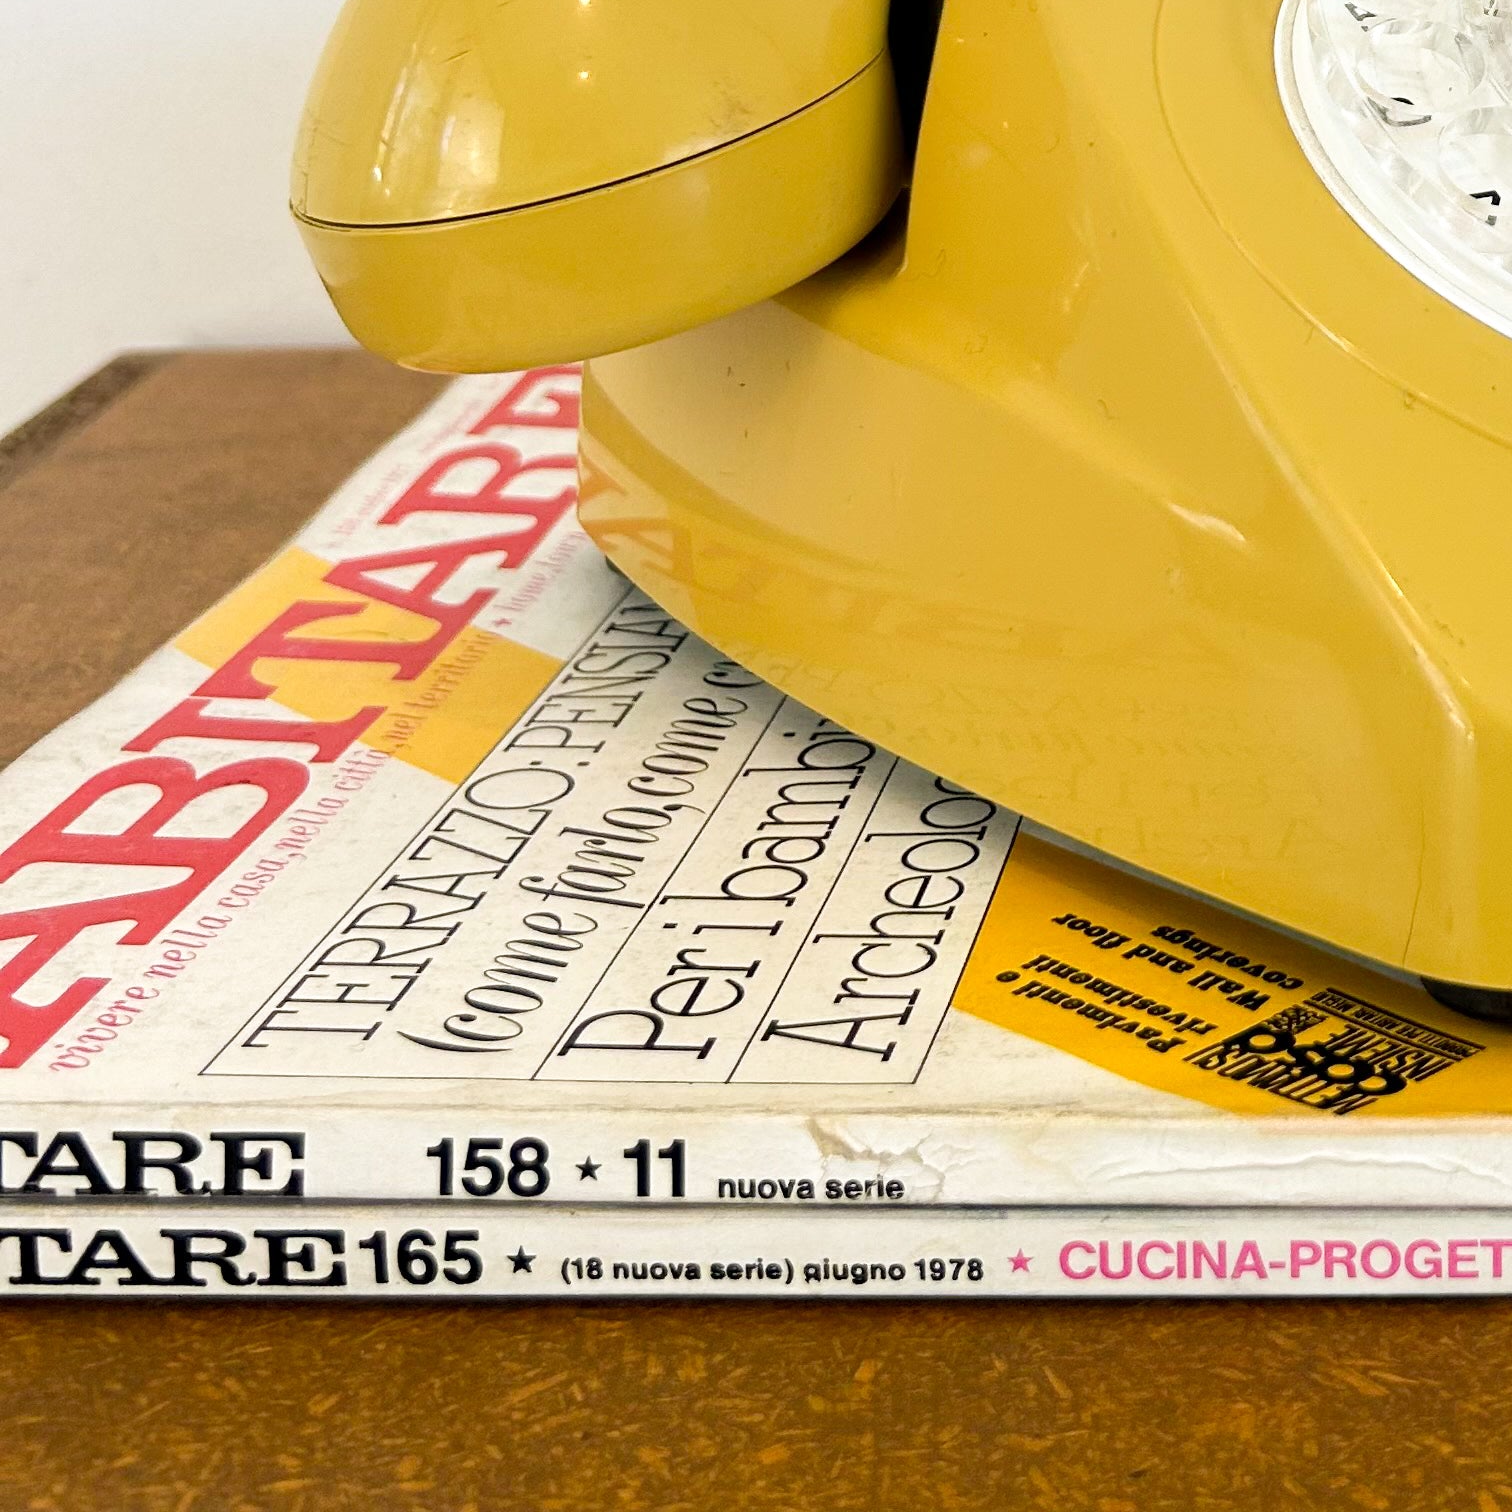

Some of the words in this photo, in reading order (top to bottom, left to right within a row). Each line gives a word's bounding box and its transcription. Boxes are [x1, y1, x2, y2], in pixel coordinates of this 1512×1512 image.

[241, 760, 591, 1049] TERRAZZO:
[503, 603, 690, 753] PENSIA
[660, 718, 876, 908] bambi
[663, 919, 784, 936] i
[761, 775, 997, 1062] Archeolo
[1051, 913, 1132, 949] floor
[396, 911, 599, 1052] (come
[996, 971, 1021, 982] e
[1121, 943, 1195, 973] and
[1151, 926, 1304, 989] coverings
[1187, 970, 1270, 1011] Wall
[49, 985, 160, 1071] vivere
[144, 915, 232, 979] nella
[557, 947, 761, 1060] Per
[1012, 980, 1187, 1052] Pavimenti
[1021, 954, 1218, 1034] rivestimenti
[425, 1136, 551, 1197] 158
[622, 1138, 686, 1197] 11
[718, 1176, 816, 1199] nuova
[825, 1174, 905, 1200] serie
[0, 1228, 347, 1286] TARE
[358, 1230, 484, 1285] 165
[560, 1257, 603, 1284] (18
[613, 1261, 701, 1280] nuova
[710, 1257, 794, 1284] serie)
[914, 1257, 984, 1281] 1978
